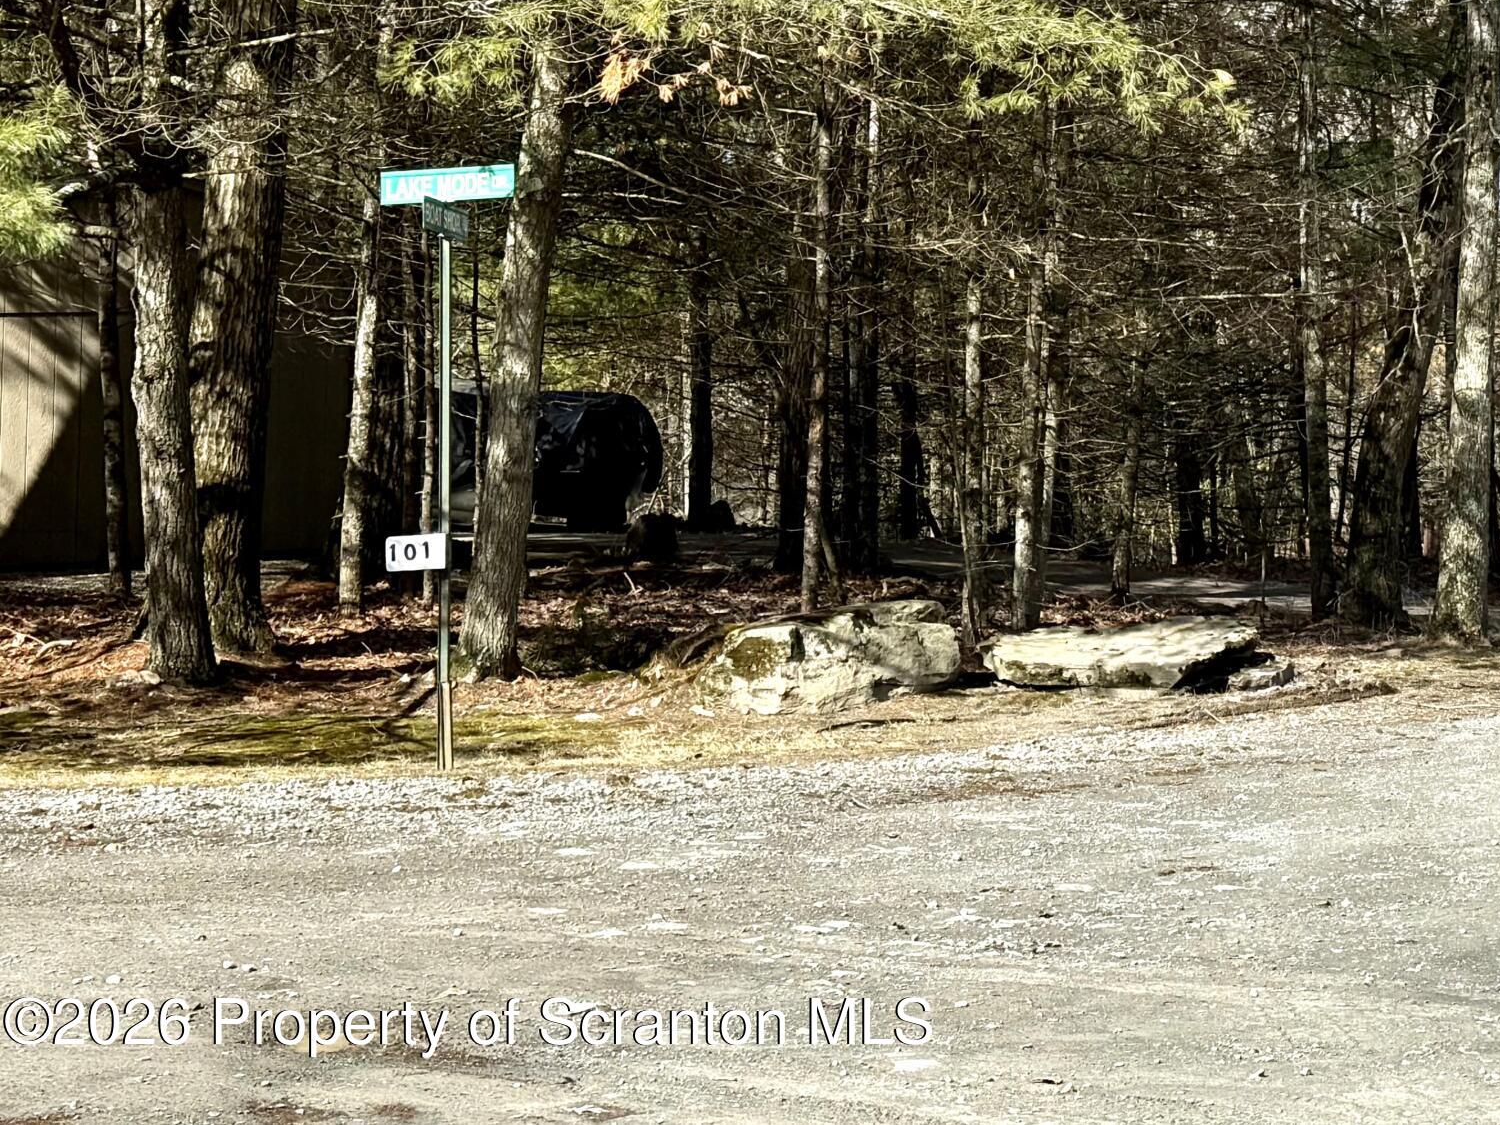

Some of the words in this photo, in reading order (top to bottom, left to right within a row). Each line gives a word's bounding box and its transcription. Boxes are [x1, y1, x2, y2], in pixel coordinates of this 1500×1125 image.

[385, 176, 433, 198] LAKE
[437, 173, 489, 195] MODE
[389, 541, 429, 562] 101
